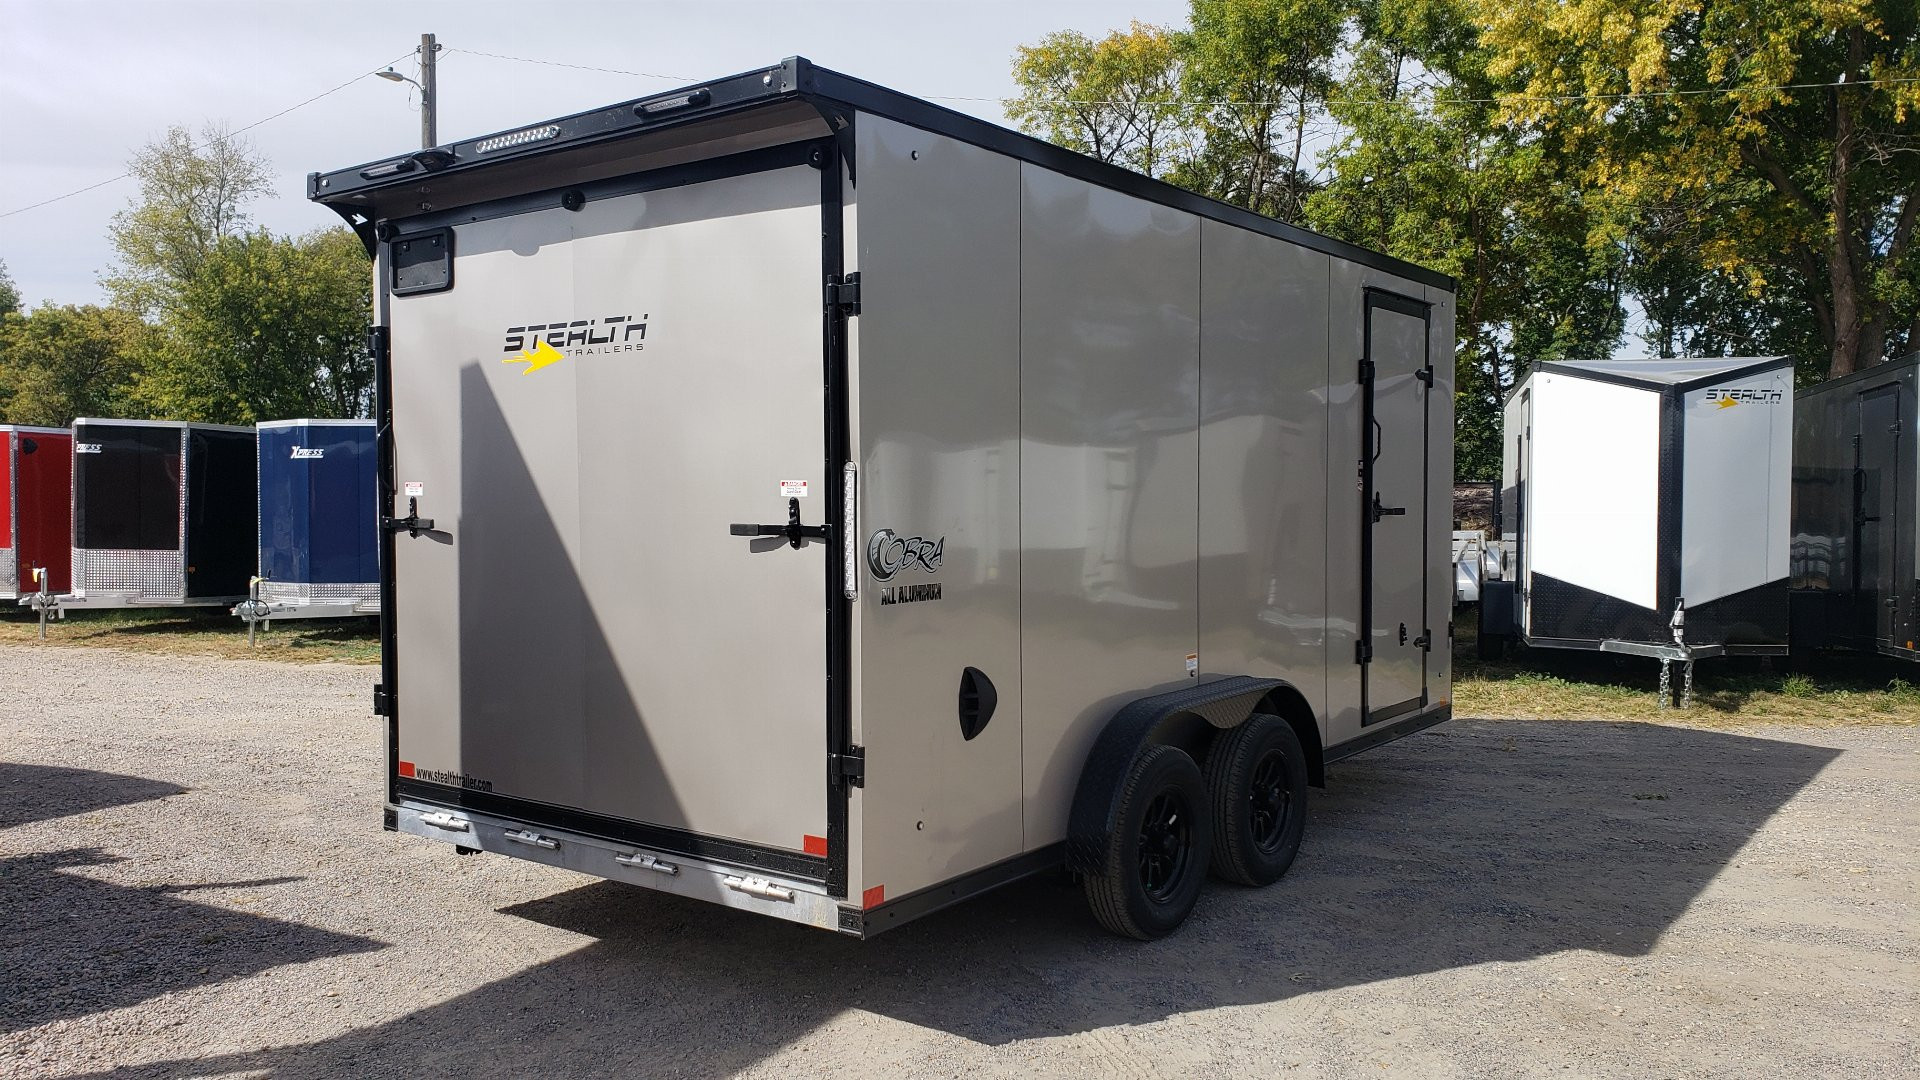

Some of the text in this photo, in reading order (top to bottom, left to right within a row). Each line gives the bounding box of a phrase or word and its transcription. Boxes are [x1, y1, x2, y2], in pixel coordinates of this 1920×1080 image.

[504, 314, 648, 352] STEALTH
[566, 343, 644, 357] TRAILERS
[1706, 389, 1782, 400] STEALTH
[867, 528, 944, 582] COBRA
[881, 583, 942, 606] ALL ALUMINUM
[416, 768, 493, 792] www.stealthtrailer.com
